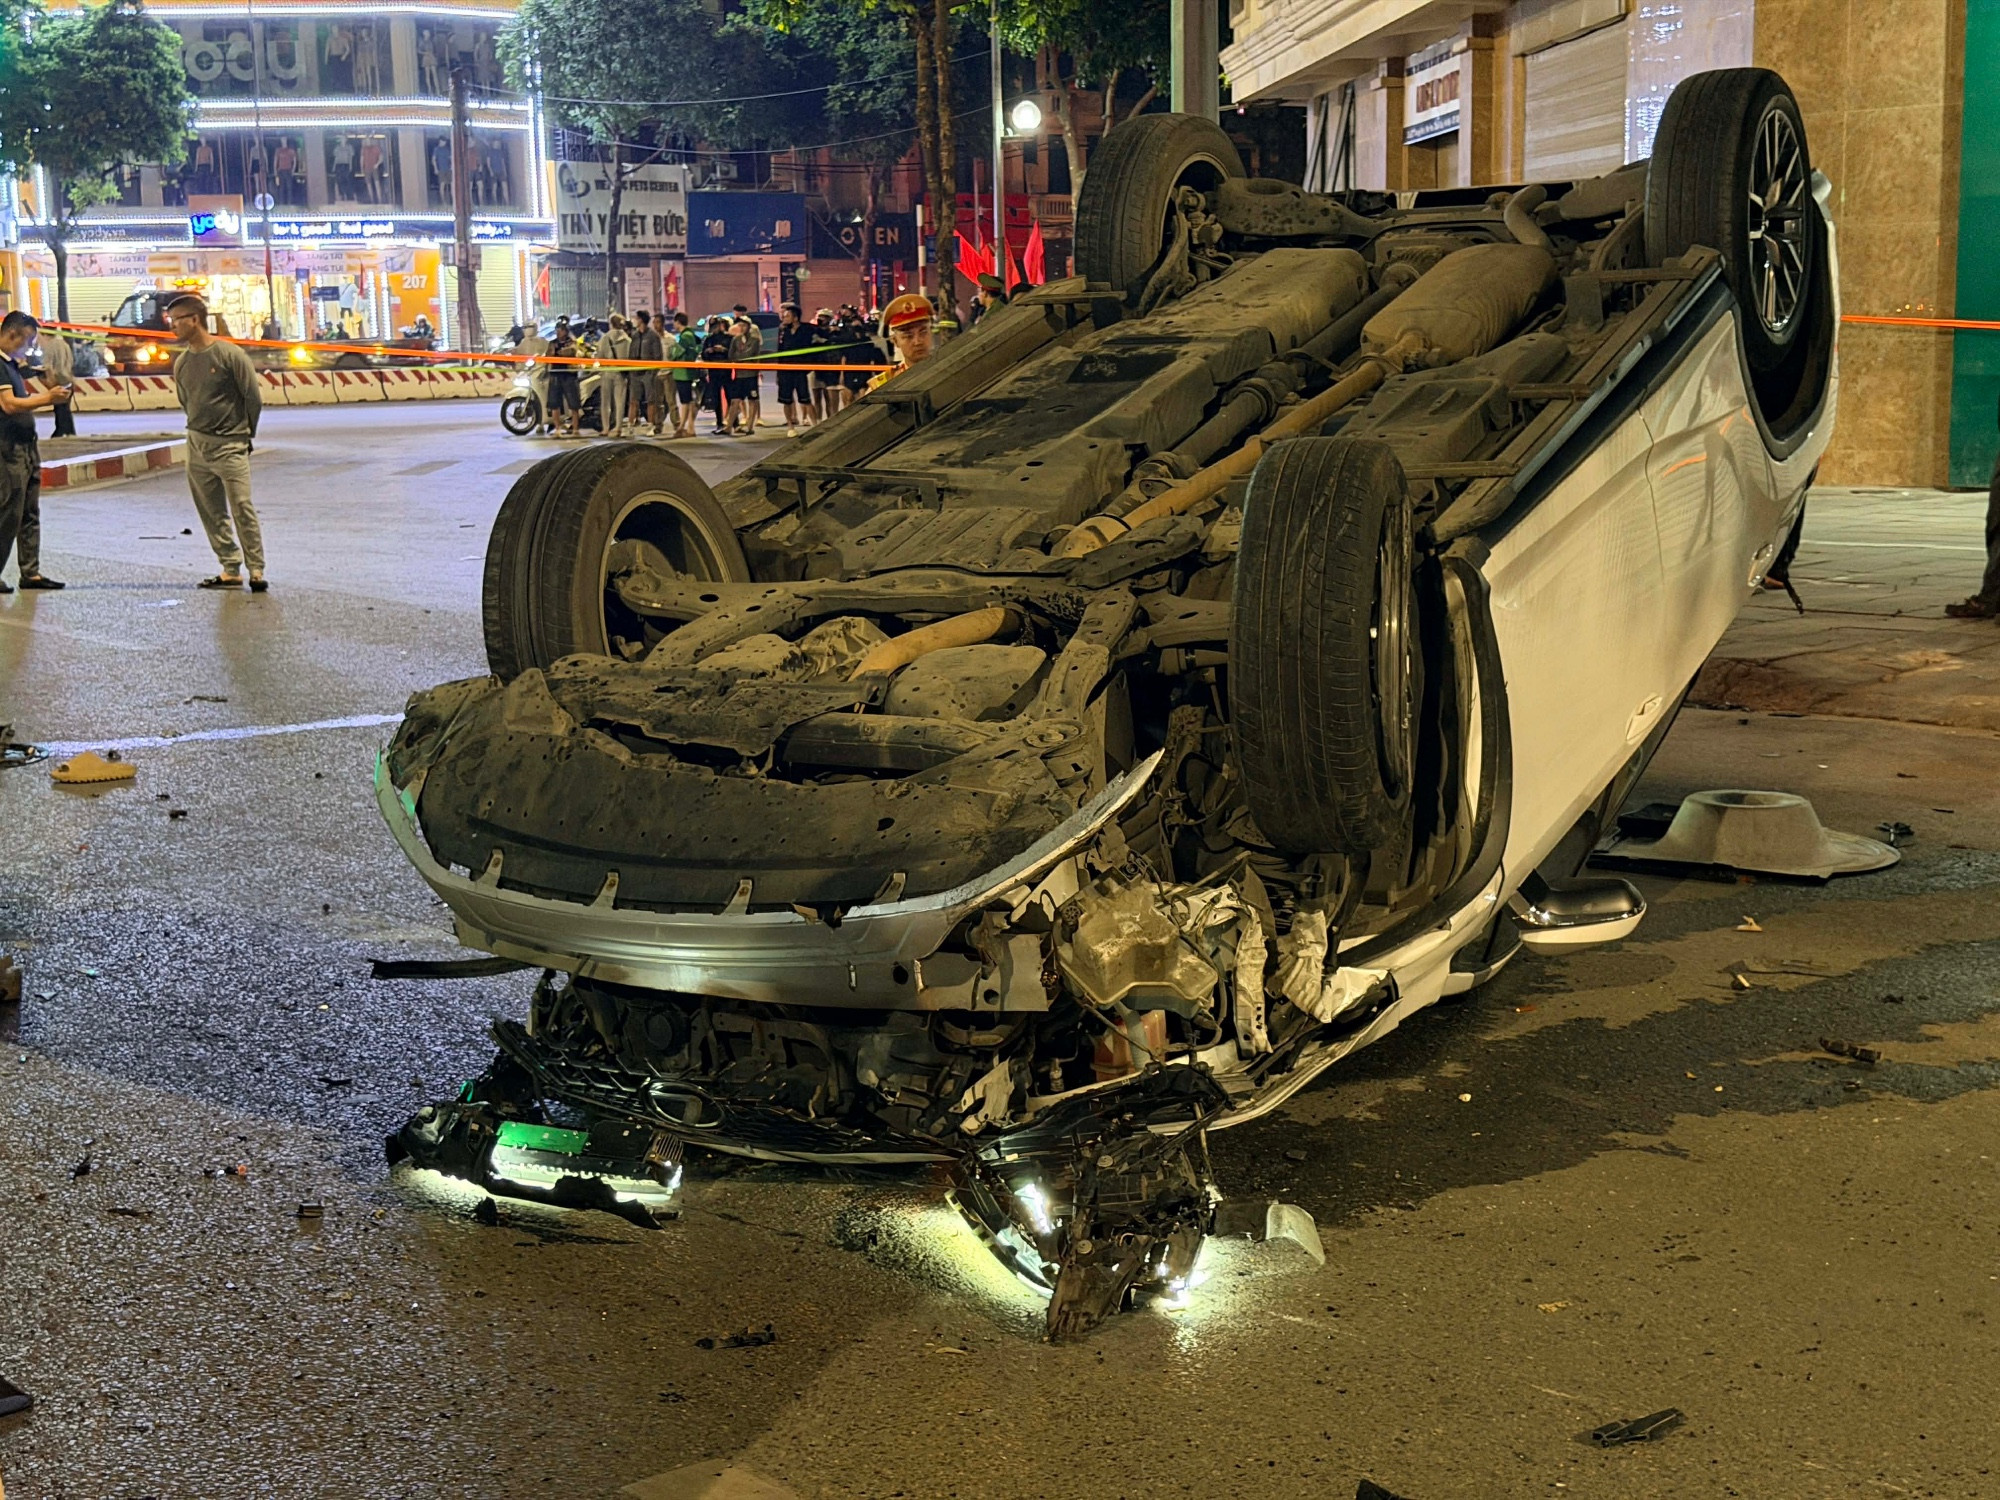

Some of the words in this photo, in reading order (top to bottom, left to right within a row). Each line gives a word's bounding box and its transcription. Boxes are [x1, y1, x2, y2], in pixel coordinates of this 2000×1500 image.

[184, 31, 306, 90] ody
[79, 226, 126, 240] yody.vn
[192, 209, 239, 235] yody
[597, 213, 607, 235] Y
[402, 275, 427, 289] 207
